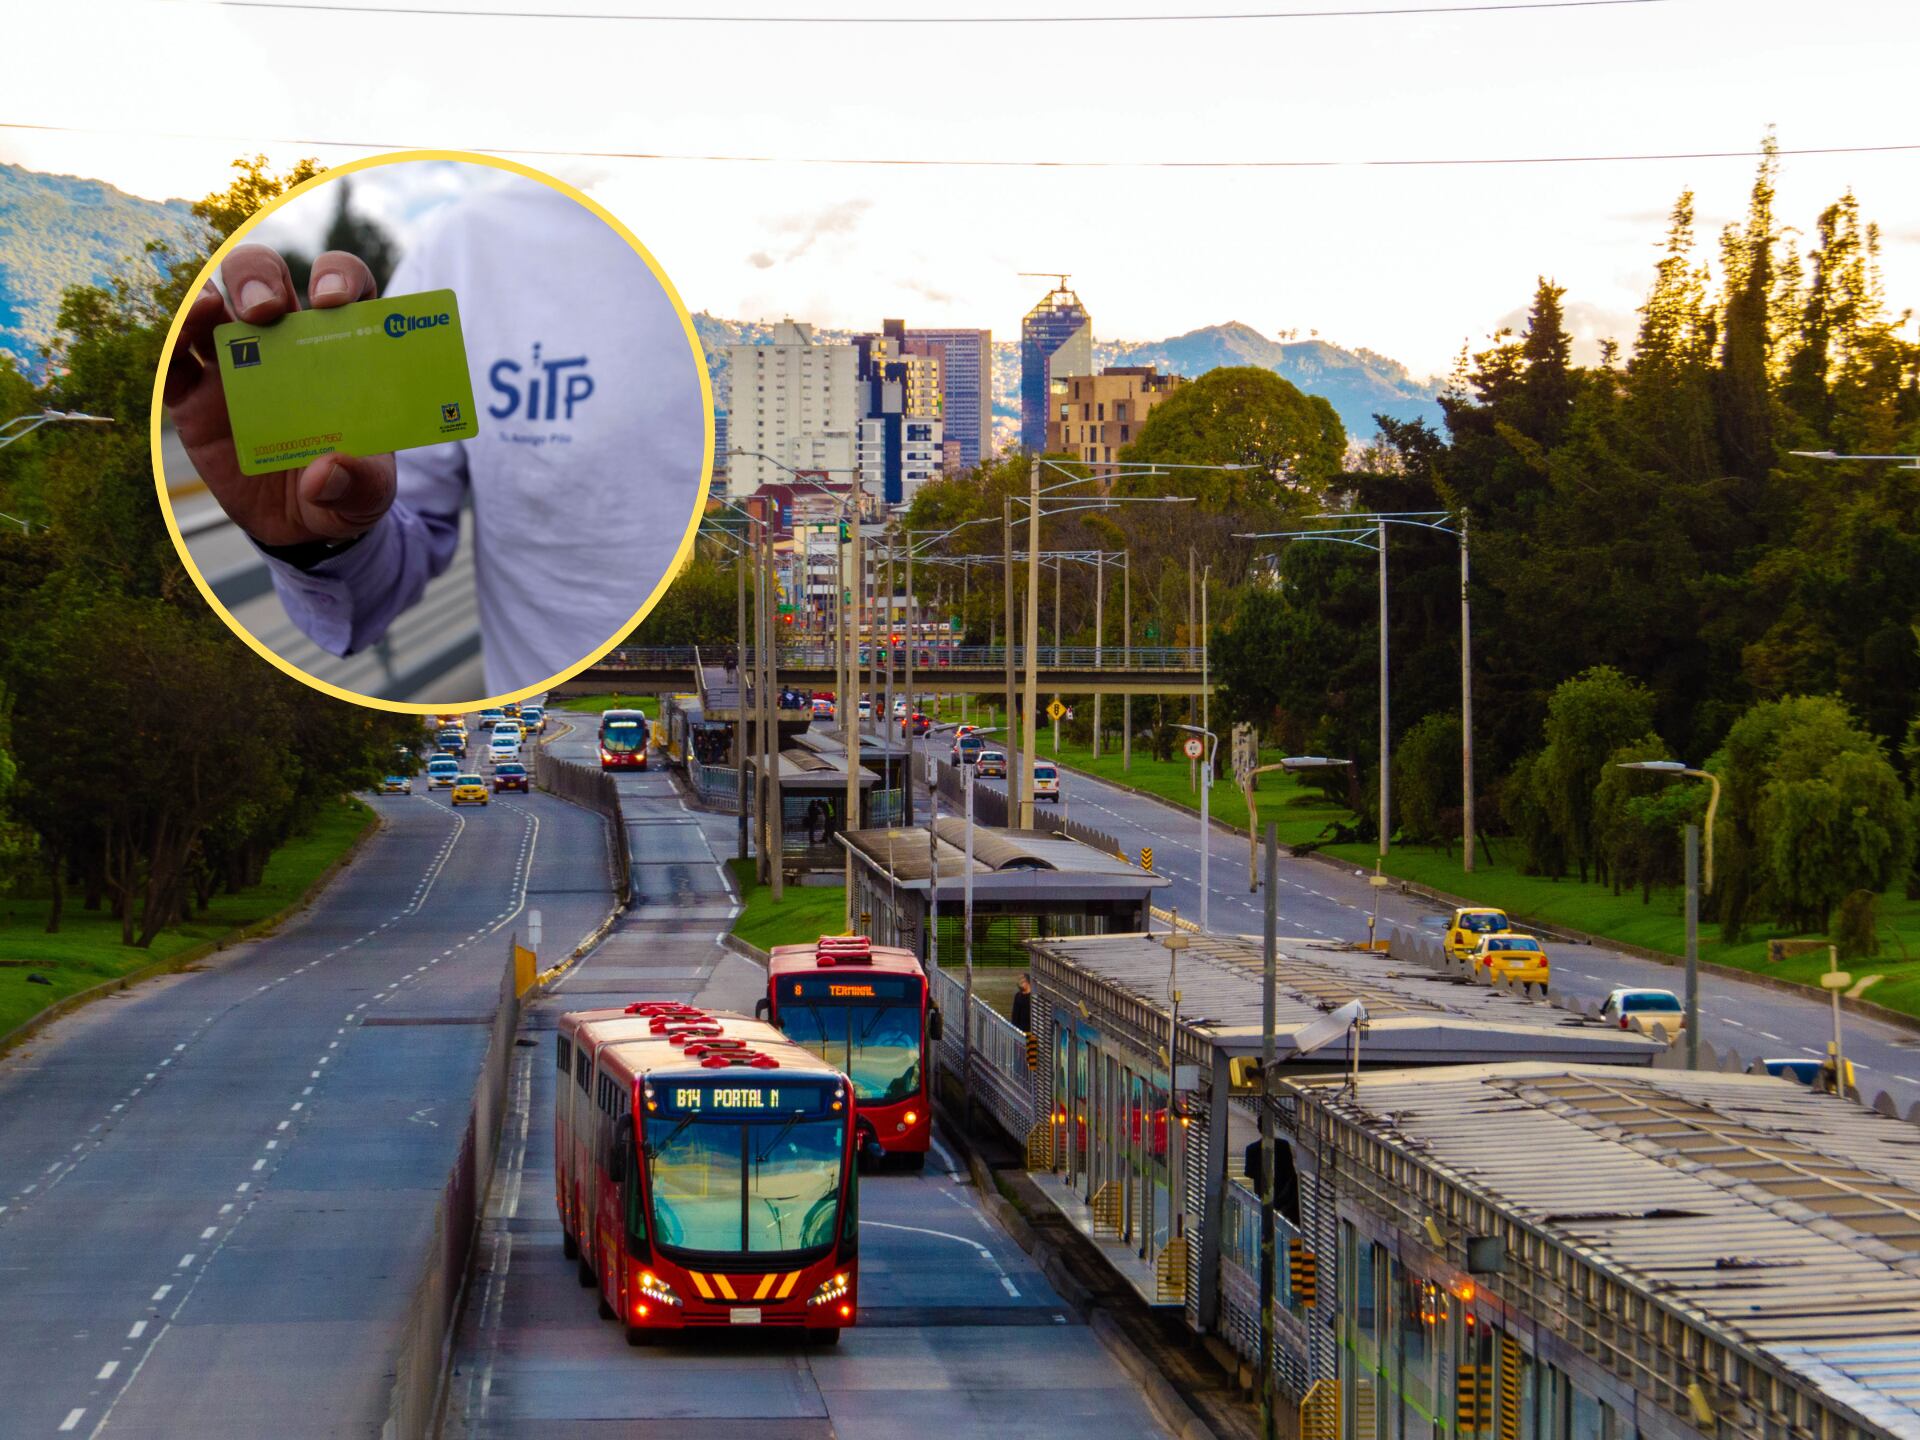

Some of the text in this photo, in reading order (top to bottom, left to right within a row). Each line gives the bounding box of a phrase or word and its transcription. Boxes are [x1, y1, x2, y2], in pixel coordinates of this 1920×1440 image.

[794, 985, 875, 996] 8 TERMINAL
[677, 1089, 701, 1107] B14
[713, 1089, 764, 1107] PORTAL
